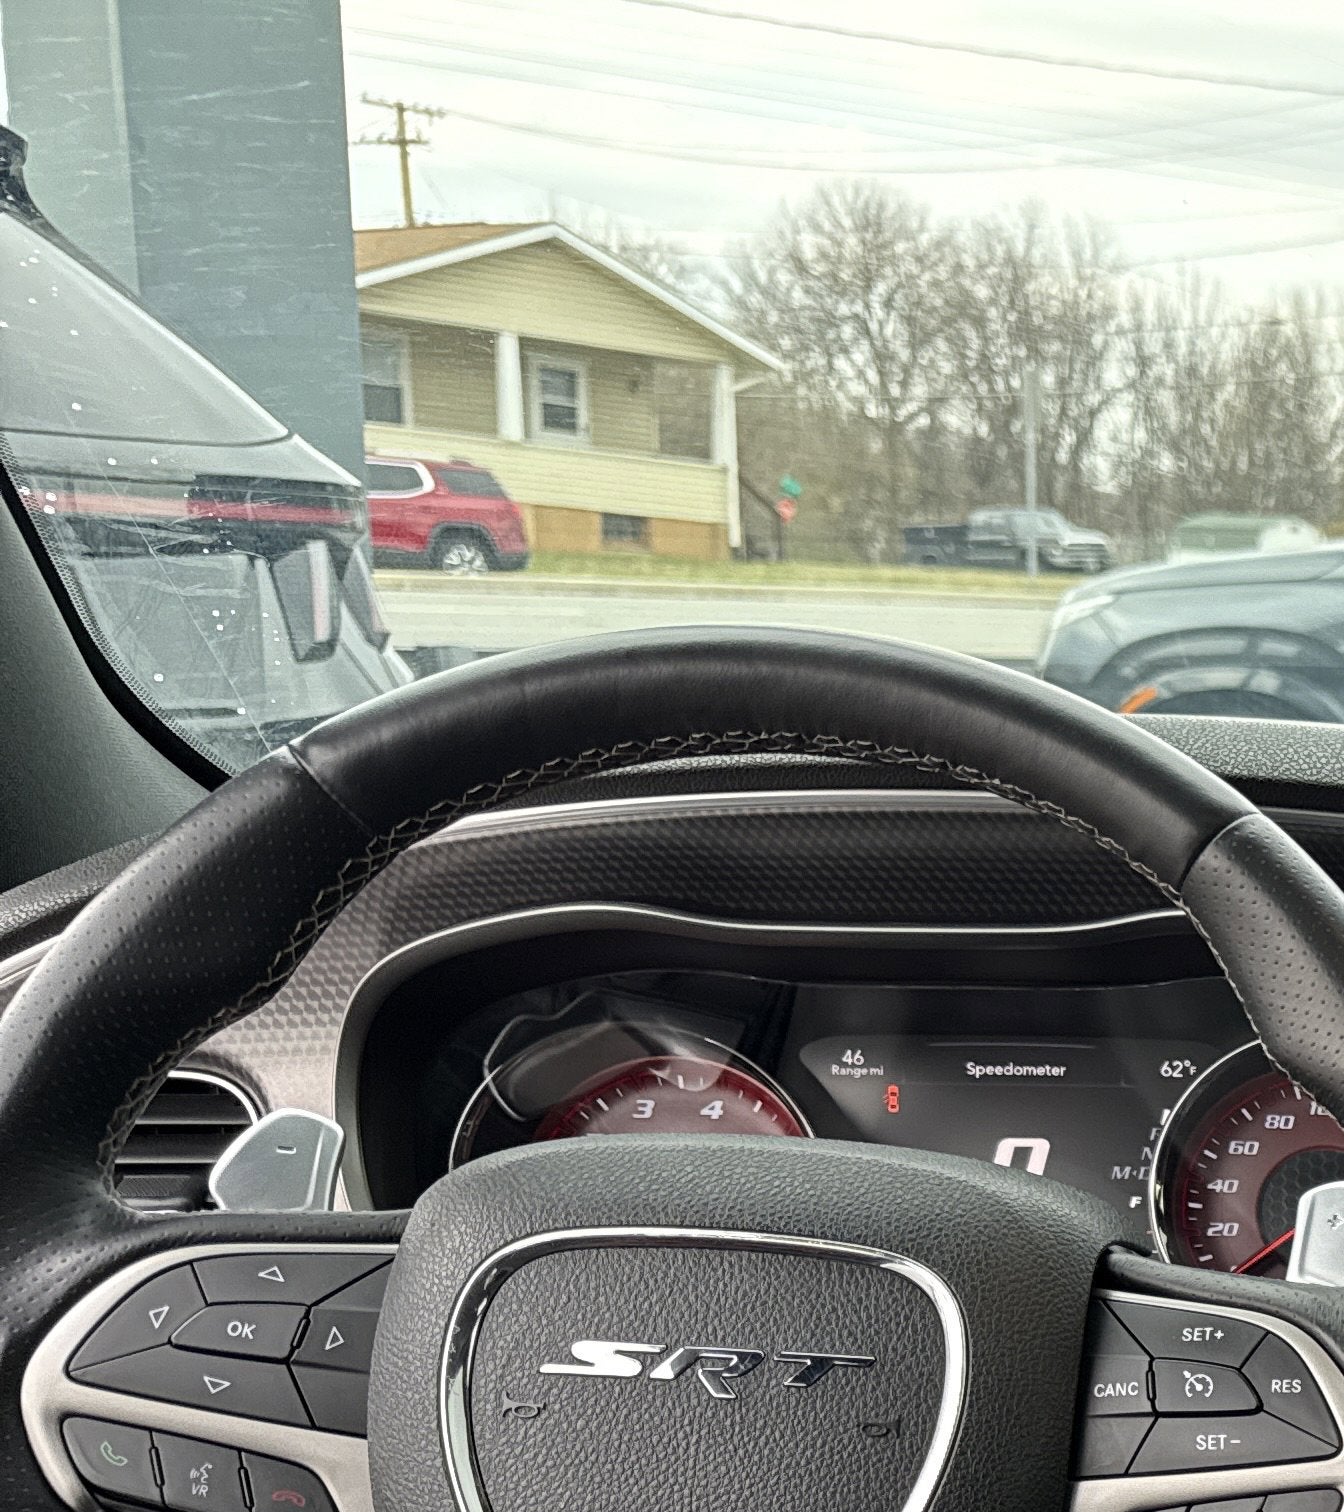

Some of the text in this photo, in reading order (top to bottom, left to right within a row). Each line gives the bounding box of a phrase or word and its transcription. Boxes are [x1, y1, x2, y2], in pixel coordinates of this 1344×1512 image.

[842, 1050, 864, 1065] 46
[832, 1062, 883, 1078] Range mi
[966, 1062, 1066, 1078] Speedometer
[633, 1100, 655, 1118] 3
[701, 1101, 723, 1119] 4
[1265, 1115, 1295, 1129] 80
[1229, 1141, 1259, 1155] 60
[1208, 1180, 1239, 1193] 40
[1207, 1223, 1239, 1236] 20
[227, 1321, 256, 1339] OK
[1182, 1327, 1224, 1341] SET+
[539, 1340, 877, 1400] SRT
[1095, 1382, 1138, 1397] CANC
[1272, 1379, 1301, 1393] RES
[192, 1482, 208, 1497] VR
